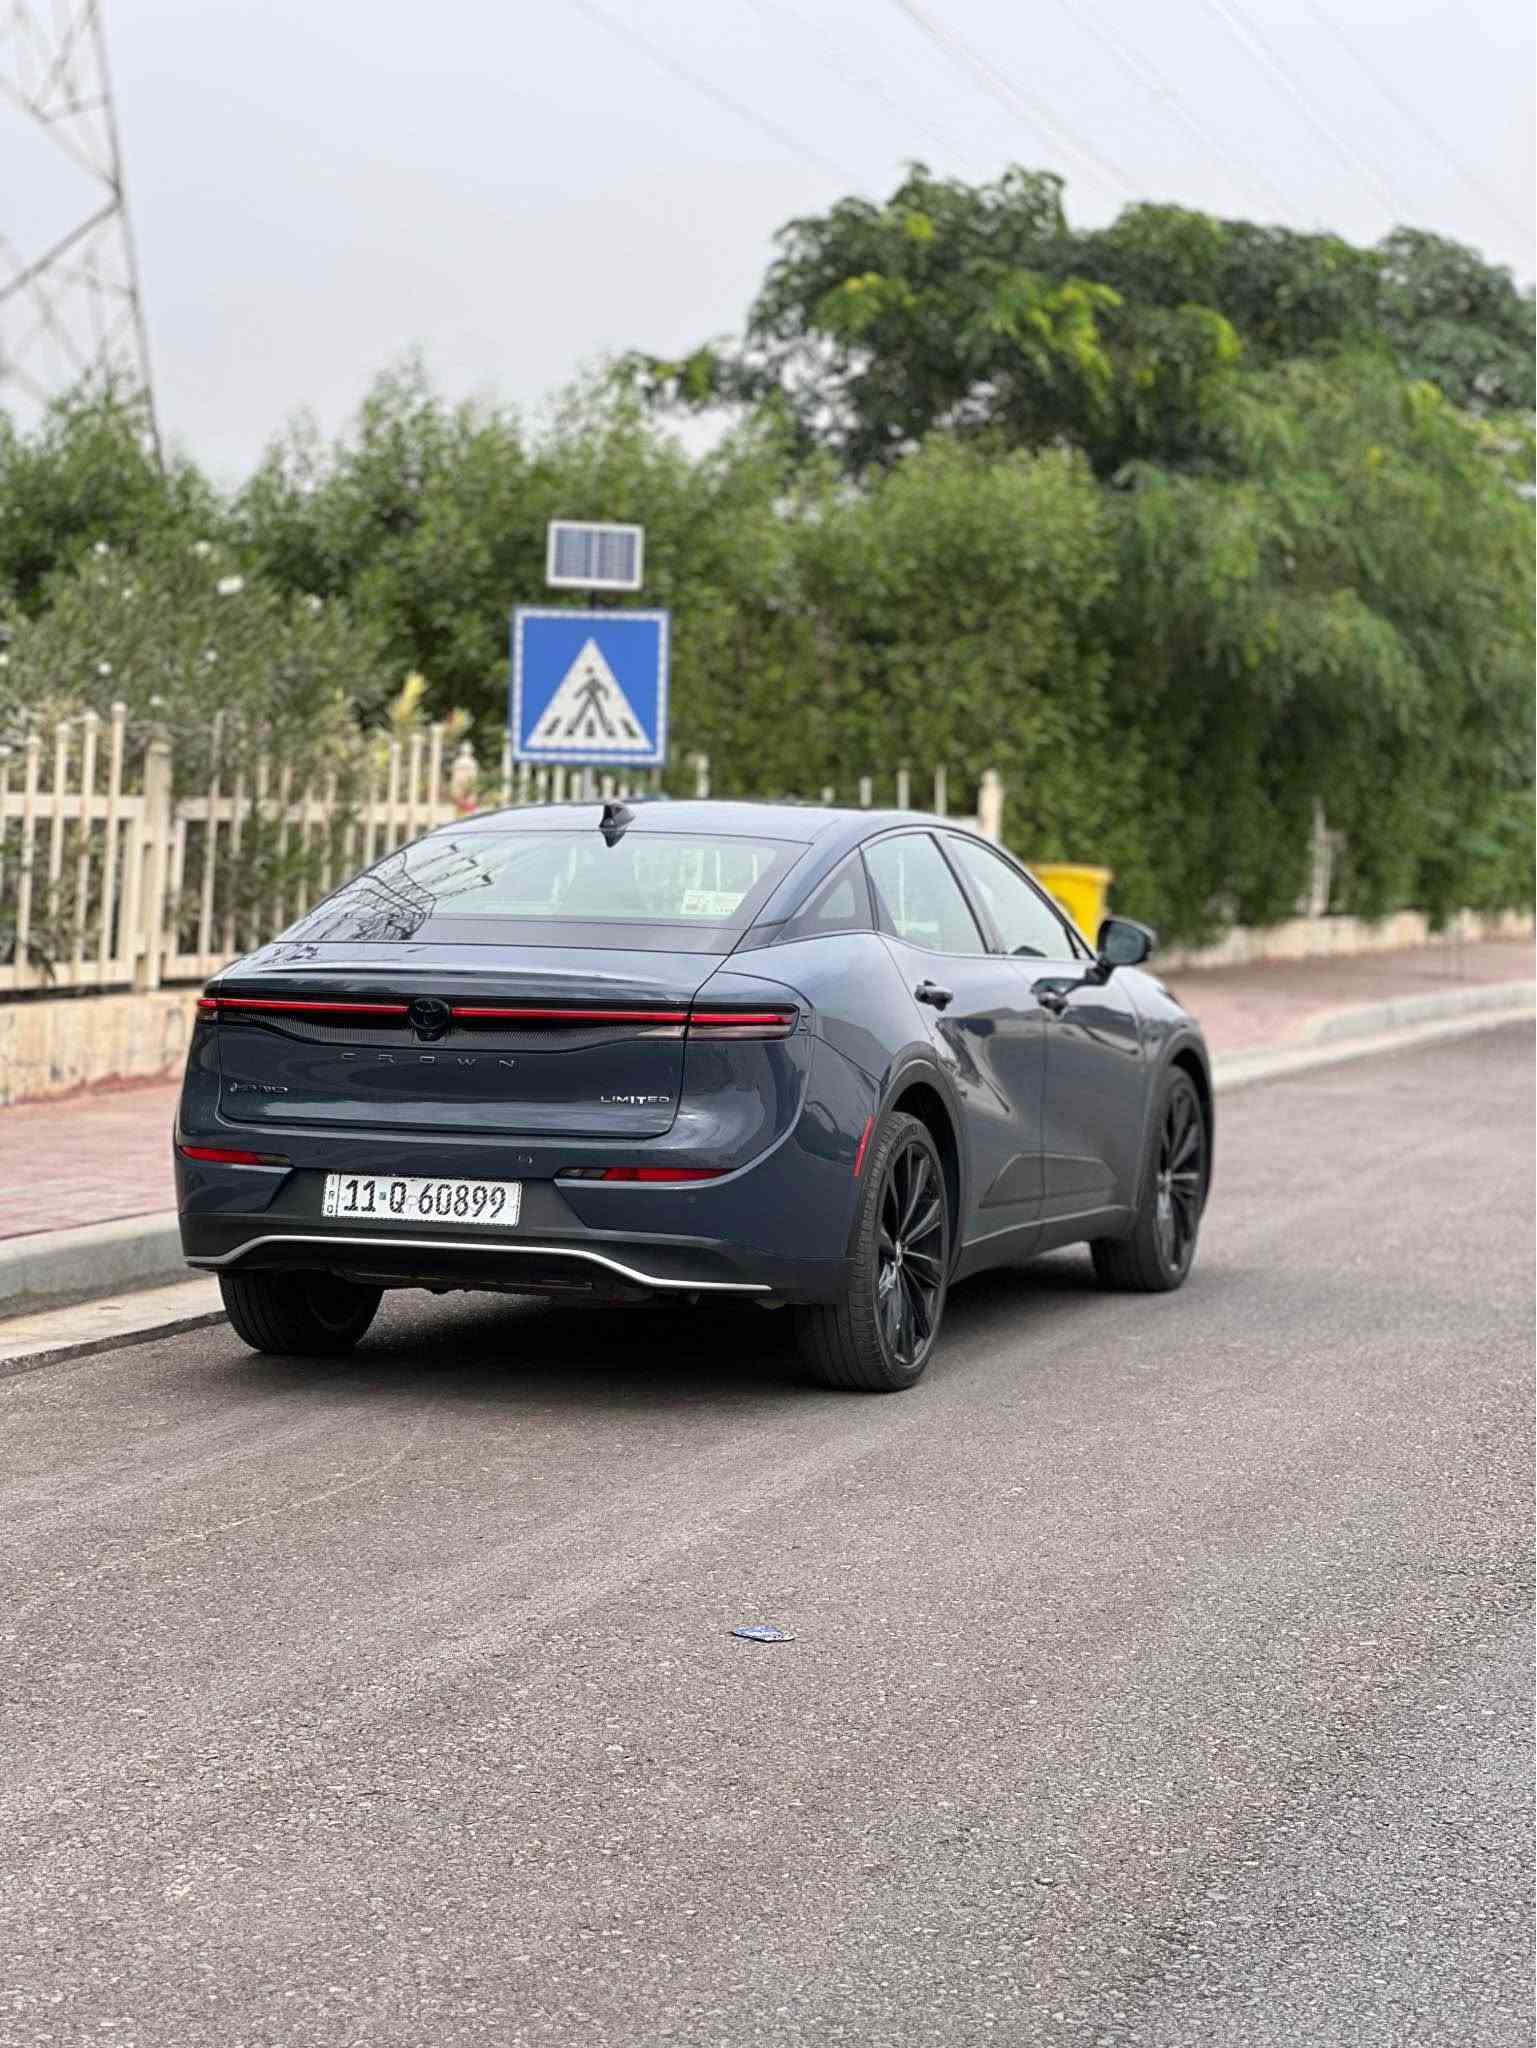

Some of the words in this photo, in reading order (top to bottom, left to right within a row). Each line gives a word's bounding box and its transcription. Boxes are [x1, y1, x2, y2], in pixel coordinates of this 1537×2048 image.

[341, 1052, 515, 1068] CROWN
[600, 1095, 671, 1105] LIMITED
[344, 1179, 376, 1212] 11
[389, 1181, 407, 1214] Q
[418, 1183, 507, 1218] 60899
